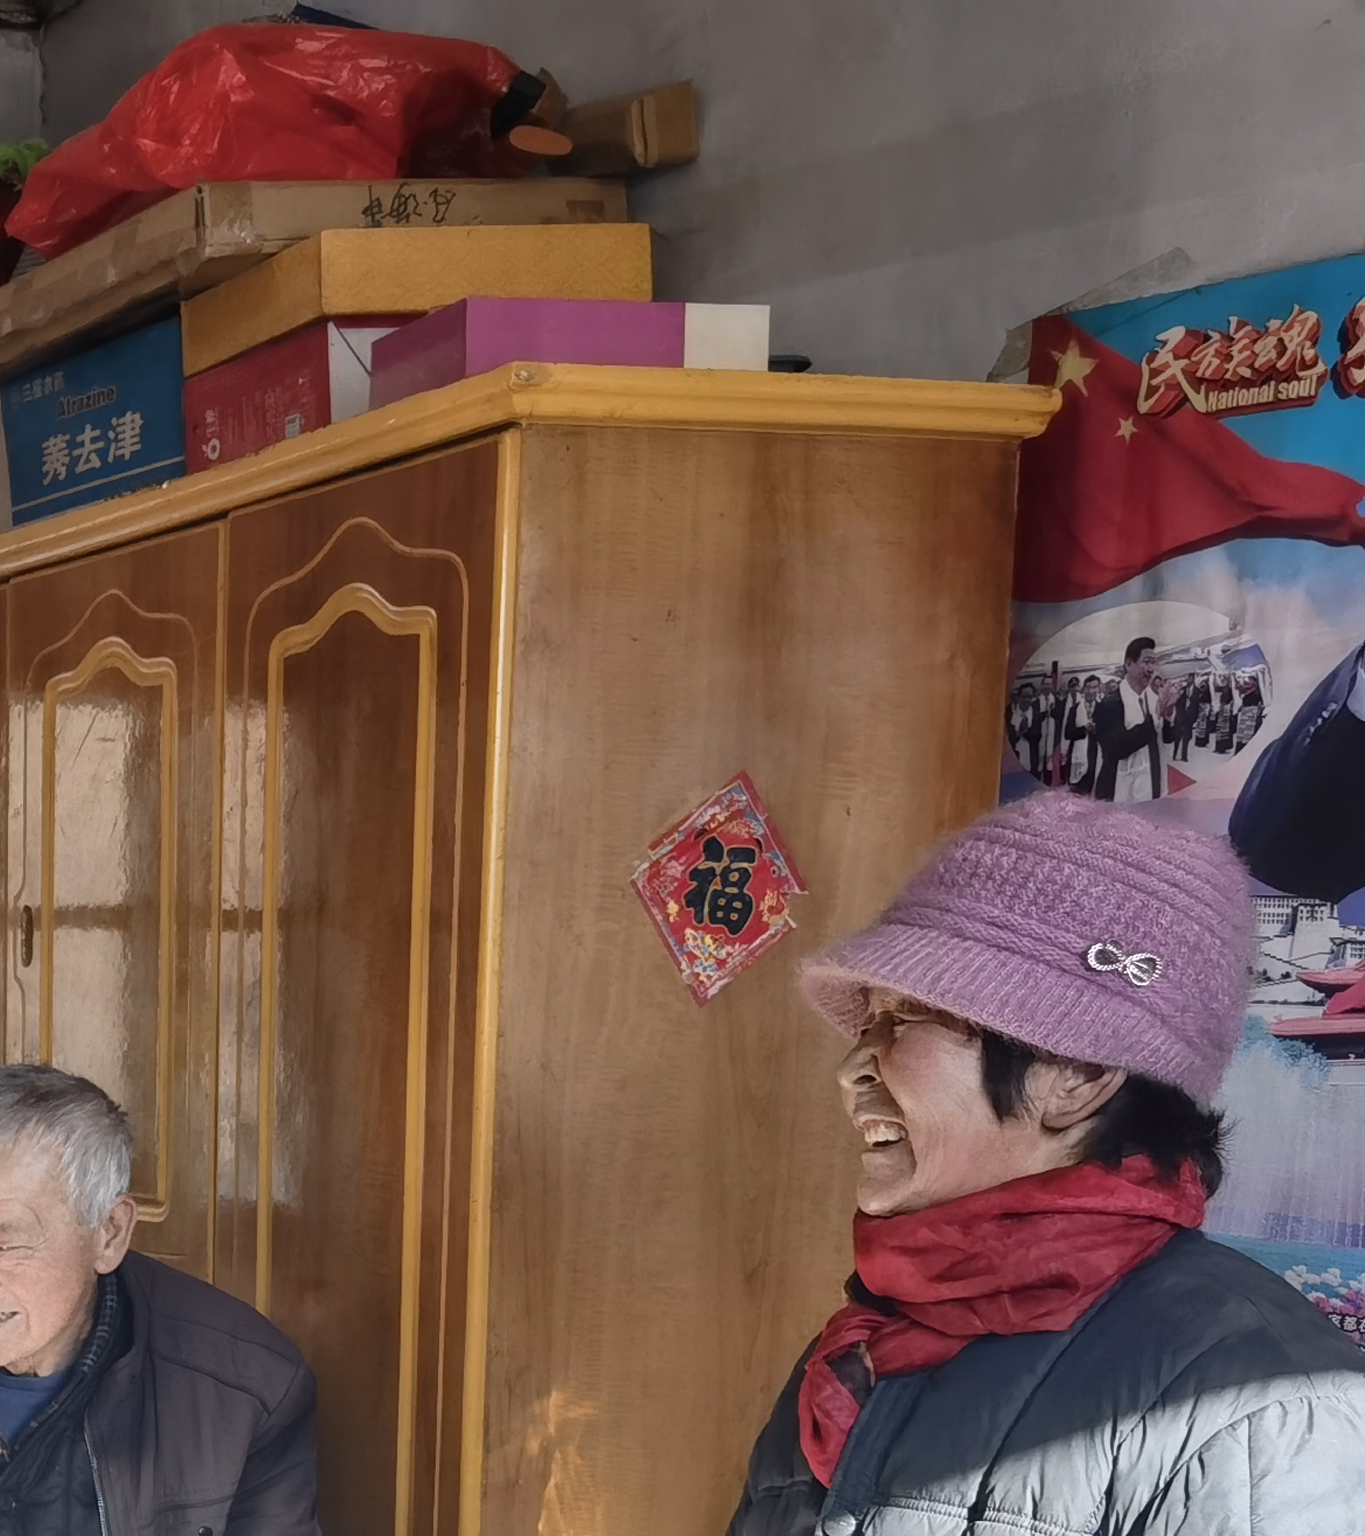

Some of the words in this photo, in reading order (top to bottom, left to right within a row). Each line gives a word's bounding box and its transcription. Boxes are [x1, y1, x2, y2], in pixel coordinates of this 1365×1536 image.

[1137, 304, 1327, 414] 民族魂
[1206, 380, 1275, 412] National
[1277, 375, 1317, 400] soul
[58, 386, 117, 419] Atrazine
[41, 411, 144, 486] 莠去津
[682, 833, 759, 938] 福
